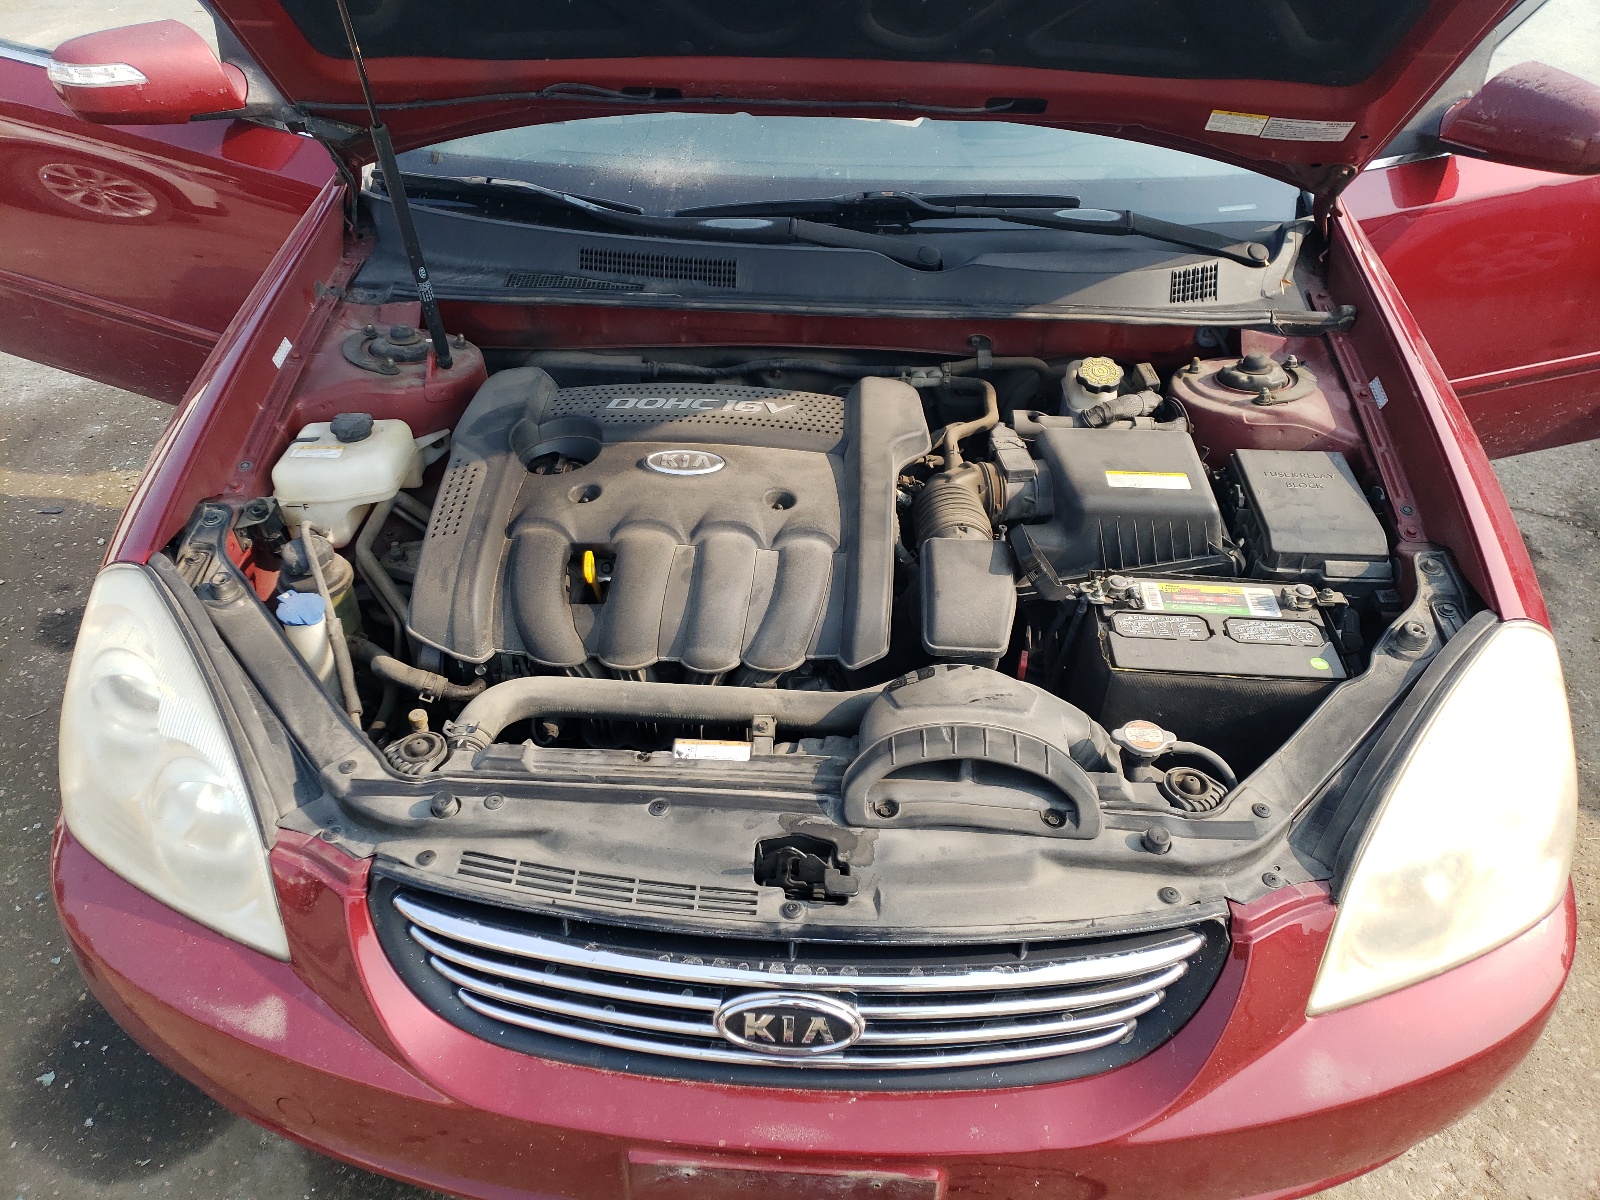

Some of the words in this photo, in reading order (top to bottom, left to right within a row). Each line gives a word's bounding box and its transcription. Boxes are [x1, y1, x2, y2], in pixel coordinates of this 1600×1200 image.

[605, 397, 720, 410] DOHC
[721, 399, 796, 414] 16V
[660, 453, 711, 469] KIA
[1285, 481, 1325, 490] BLOCK
[743, 1012, 836, 1044] KIA
